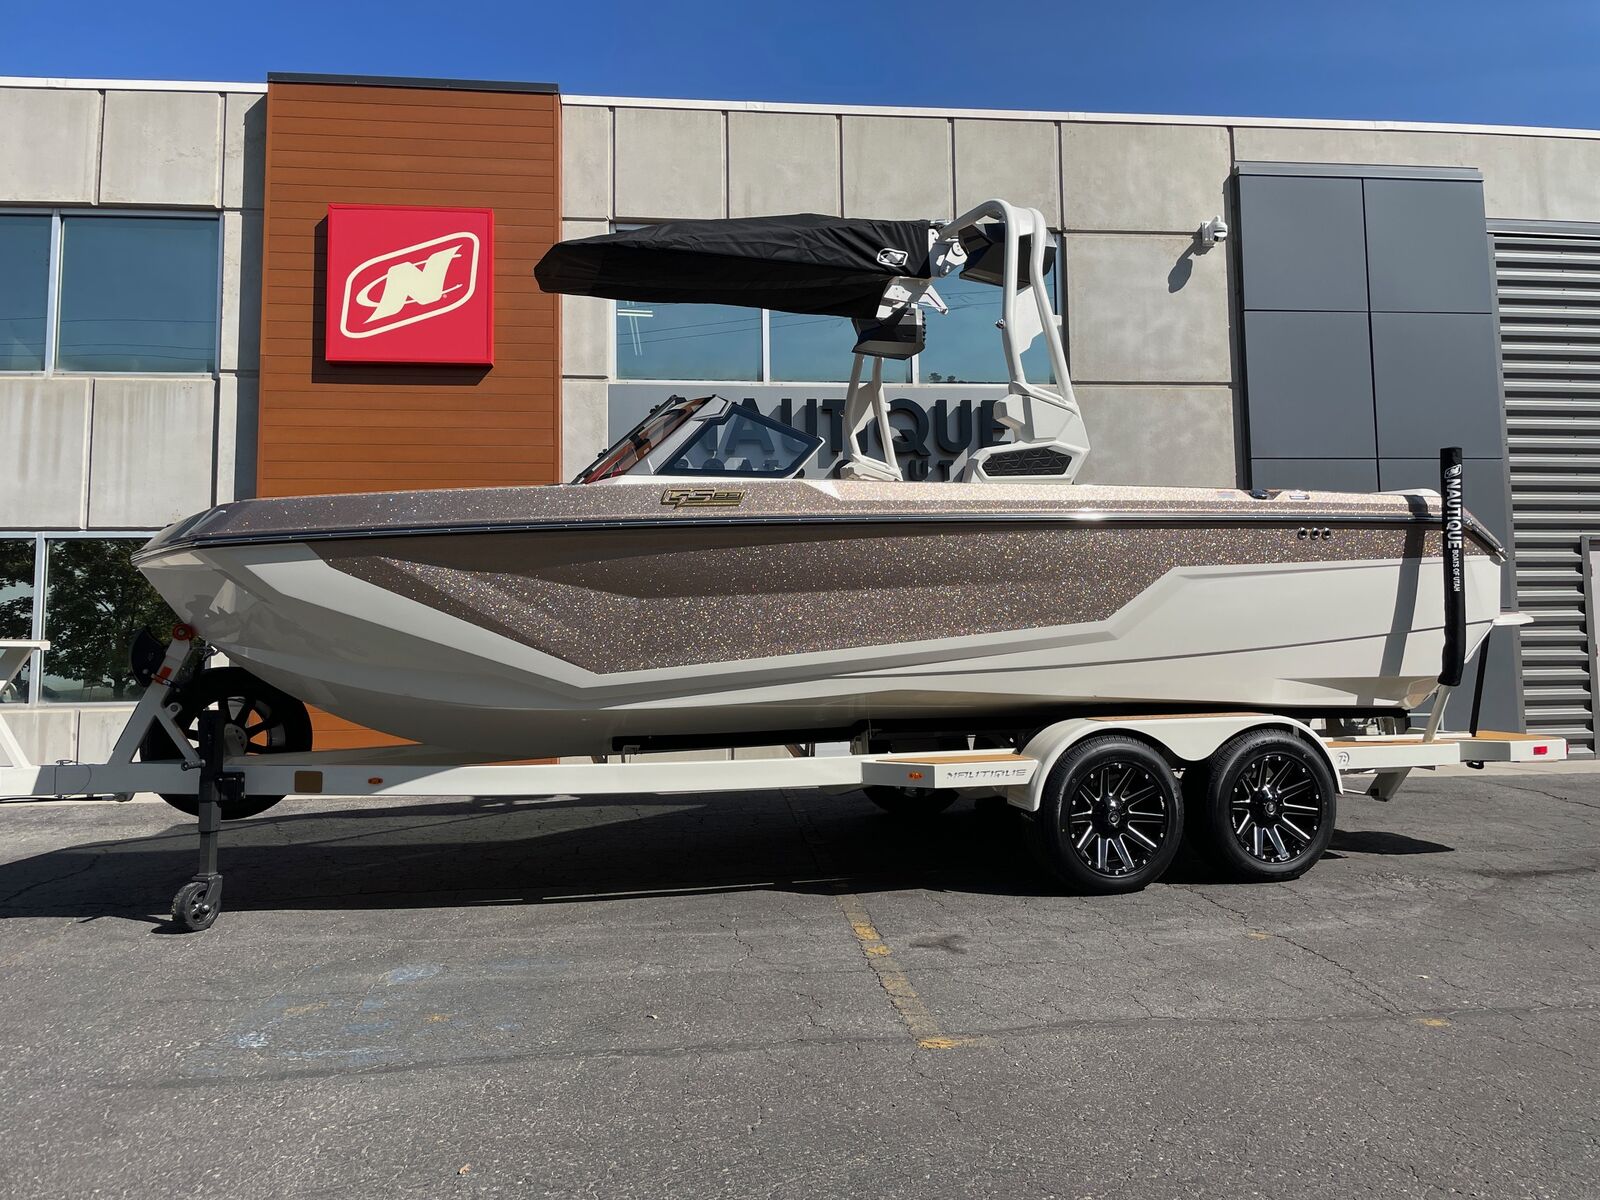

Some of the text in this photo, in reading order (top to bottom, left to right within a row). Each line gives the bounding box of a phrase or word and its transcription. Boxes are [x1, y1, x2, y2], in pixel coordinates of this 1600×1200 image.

[1446, 478, 1463, 592] NAUTIQUE BOATS OF UTAH
[946, 769, 1027, 780] NAUTIQUE
